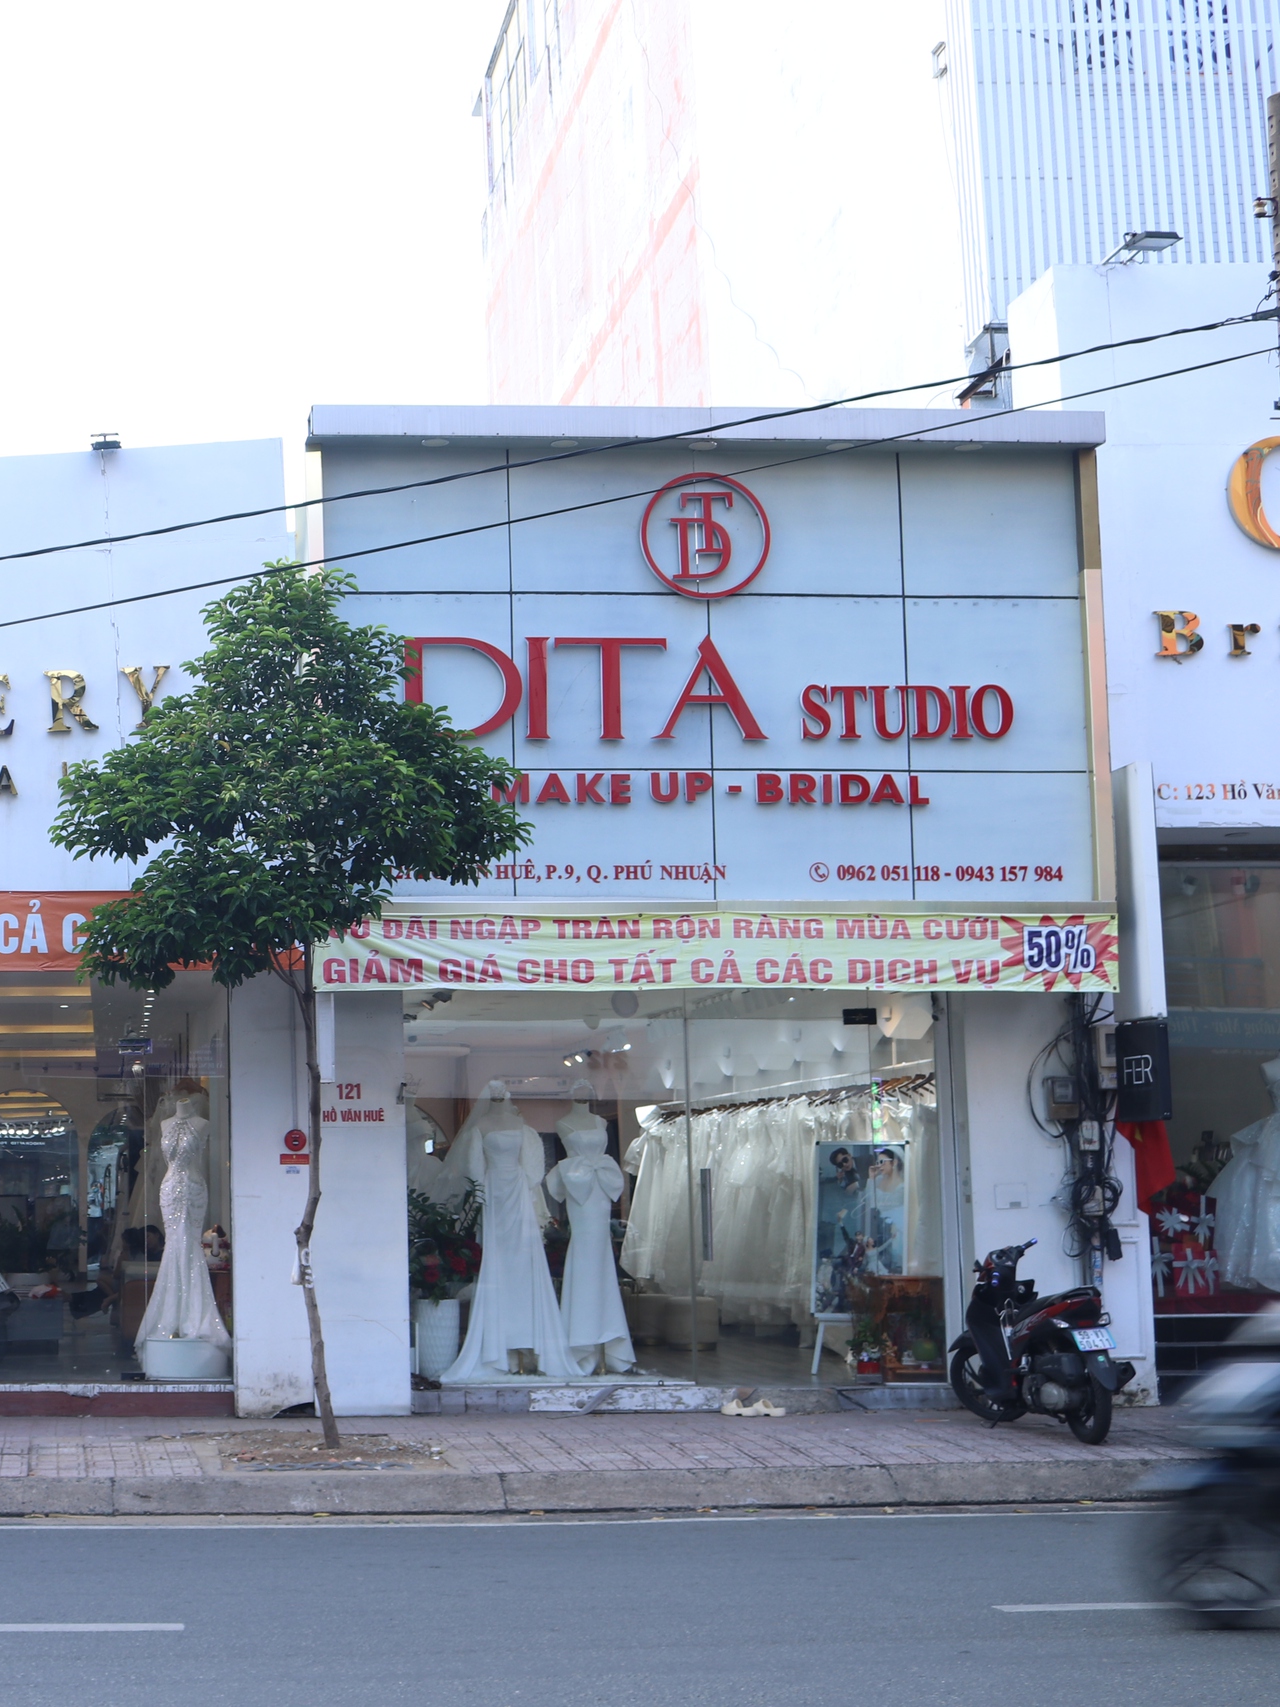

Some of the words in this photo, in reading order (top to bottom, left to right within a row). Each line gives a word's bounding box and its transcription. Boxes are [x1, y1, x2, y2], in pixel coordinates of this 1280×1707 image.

[404, 634, 769, 741] DITA
[800, 683, 1015, 741] STUDIO
[492, 771, 632, 805] MAKE
[650, 771, 713, 804] UP
[756, 773, 931, 806] BRIDAL
[1184, 783, 1216, 800] 123
[1221, 779, 1248, 800] Hồ
[495, 859, 542, 883] HUÊ,
[545, 864, 581, 883] P.9,
[586, 864, 609, 884] Q.
[613, 859, 653, 880] PHÚ
[660, 862, 727, 884] NHUẬN
[836, 864, 876, 881] 0962
[881, 864, 910, 881] 051
[913, 865, 940, 882] 118
[955, 865, 995, 882] 0943
[999, 865, 1028, 882] 157
[1034, 865, 1064, 882] 984
[381, 915, 438, 940] ĐÃI
[449, 914, 541, 944] NGẬP
[552, 915, 641, 940] TRÀN
[652, 914, 721, 944] RỘN
[732, 914, 824, 940] RÀNG
[835, 914, 912, 940] MÙA
[922, 914, 1002, 940] CƯỚI
[1025, 928, 1093, 973] 50%
[322, 949, 424, 984] GIẢM
[437, 954, 504, 984] GIÁ
[516, 958, 595, 984] CHO
[607, 949, 677, 984] TẤT
[690, 949, 743, 984] CẢ
[755, 952, 834, 984] CÁC
[847, 958, 938, 989] DỊCH
[951, 958, 1003, 989] VỤ
[336, 1083, 362, 1100] 121
[322, 1106, 338, 1122] HỒ
[340, 1108, 362, 1122] VĂN
[363, 1107, 385, 1122] HUÊ
